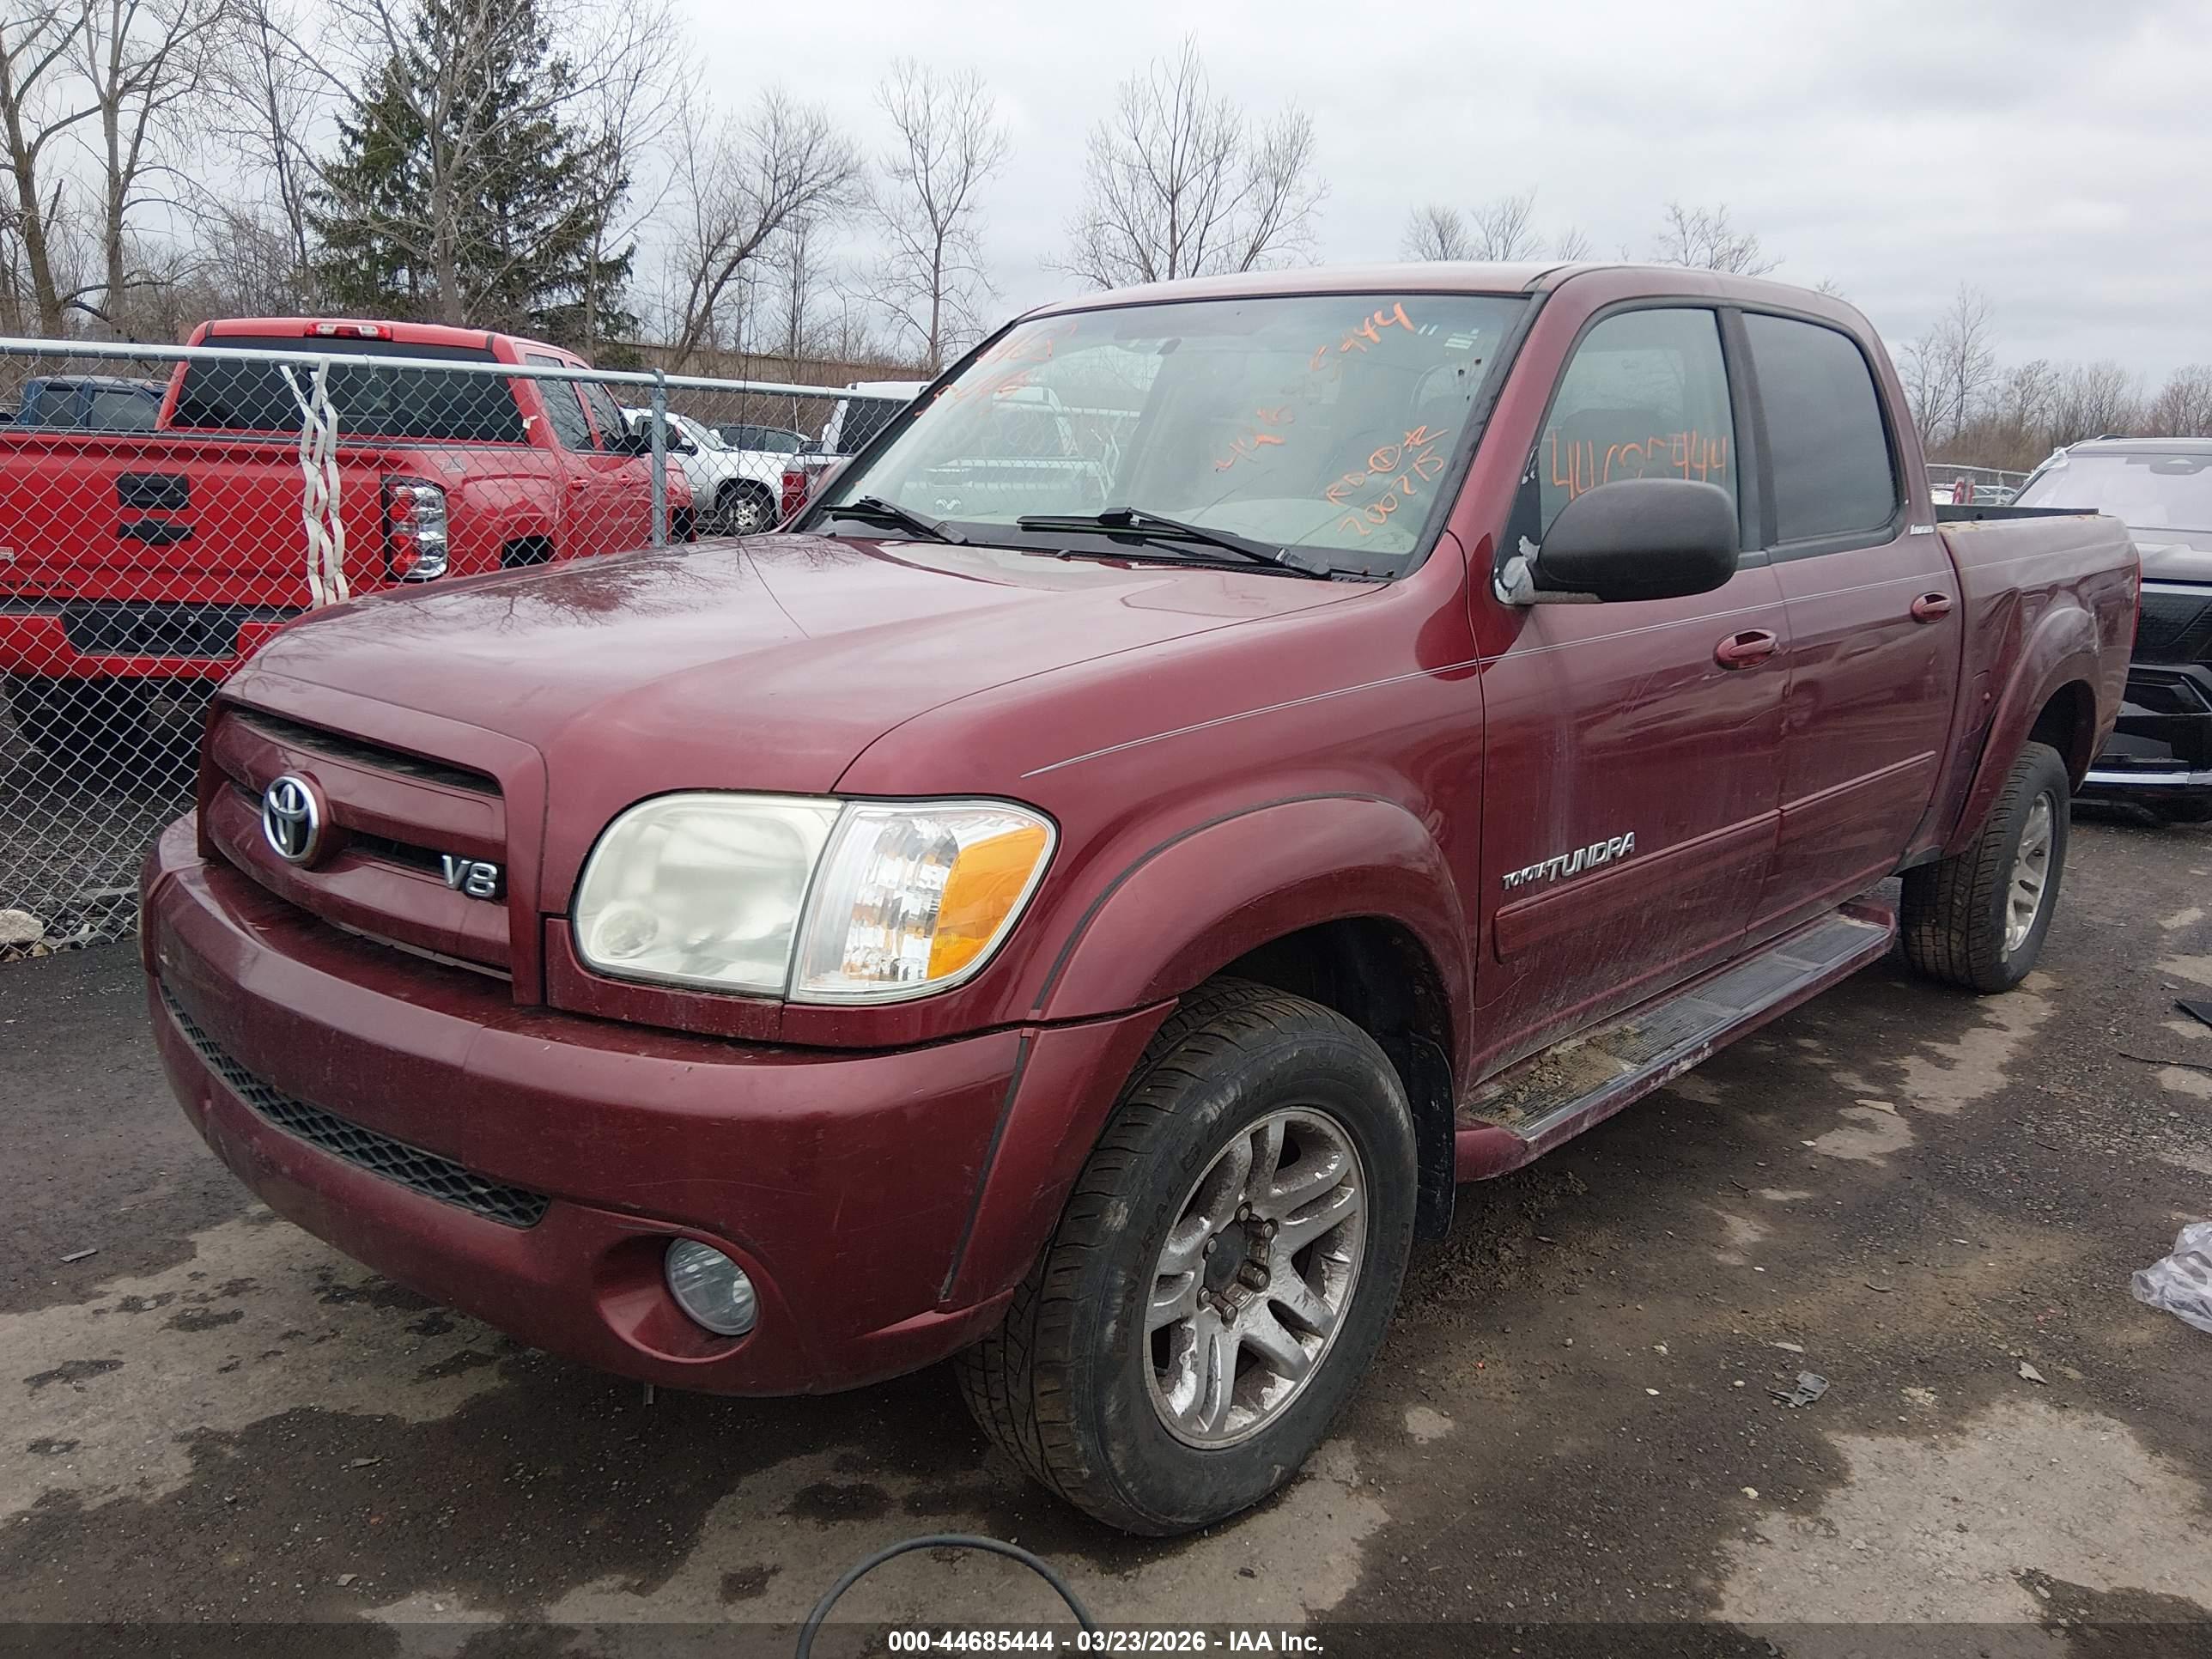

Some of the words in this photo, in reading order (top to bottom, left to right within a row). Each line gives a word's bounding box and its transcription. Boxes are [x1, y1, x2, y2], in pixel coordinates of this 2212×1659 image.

[441, 854, 498, 898] V8
[1503, 860, 1547, 890] TOYOTA
[1545, 831, 1636, 883] TUNDRA
